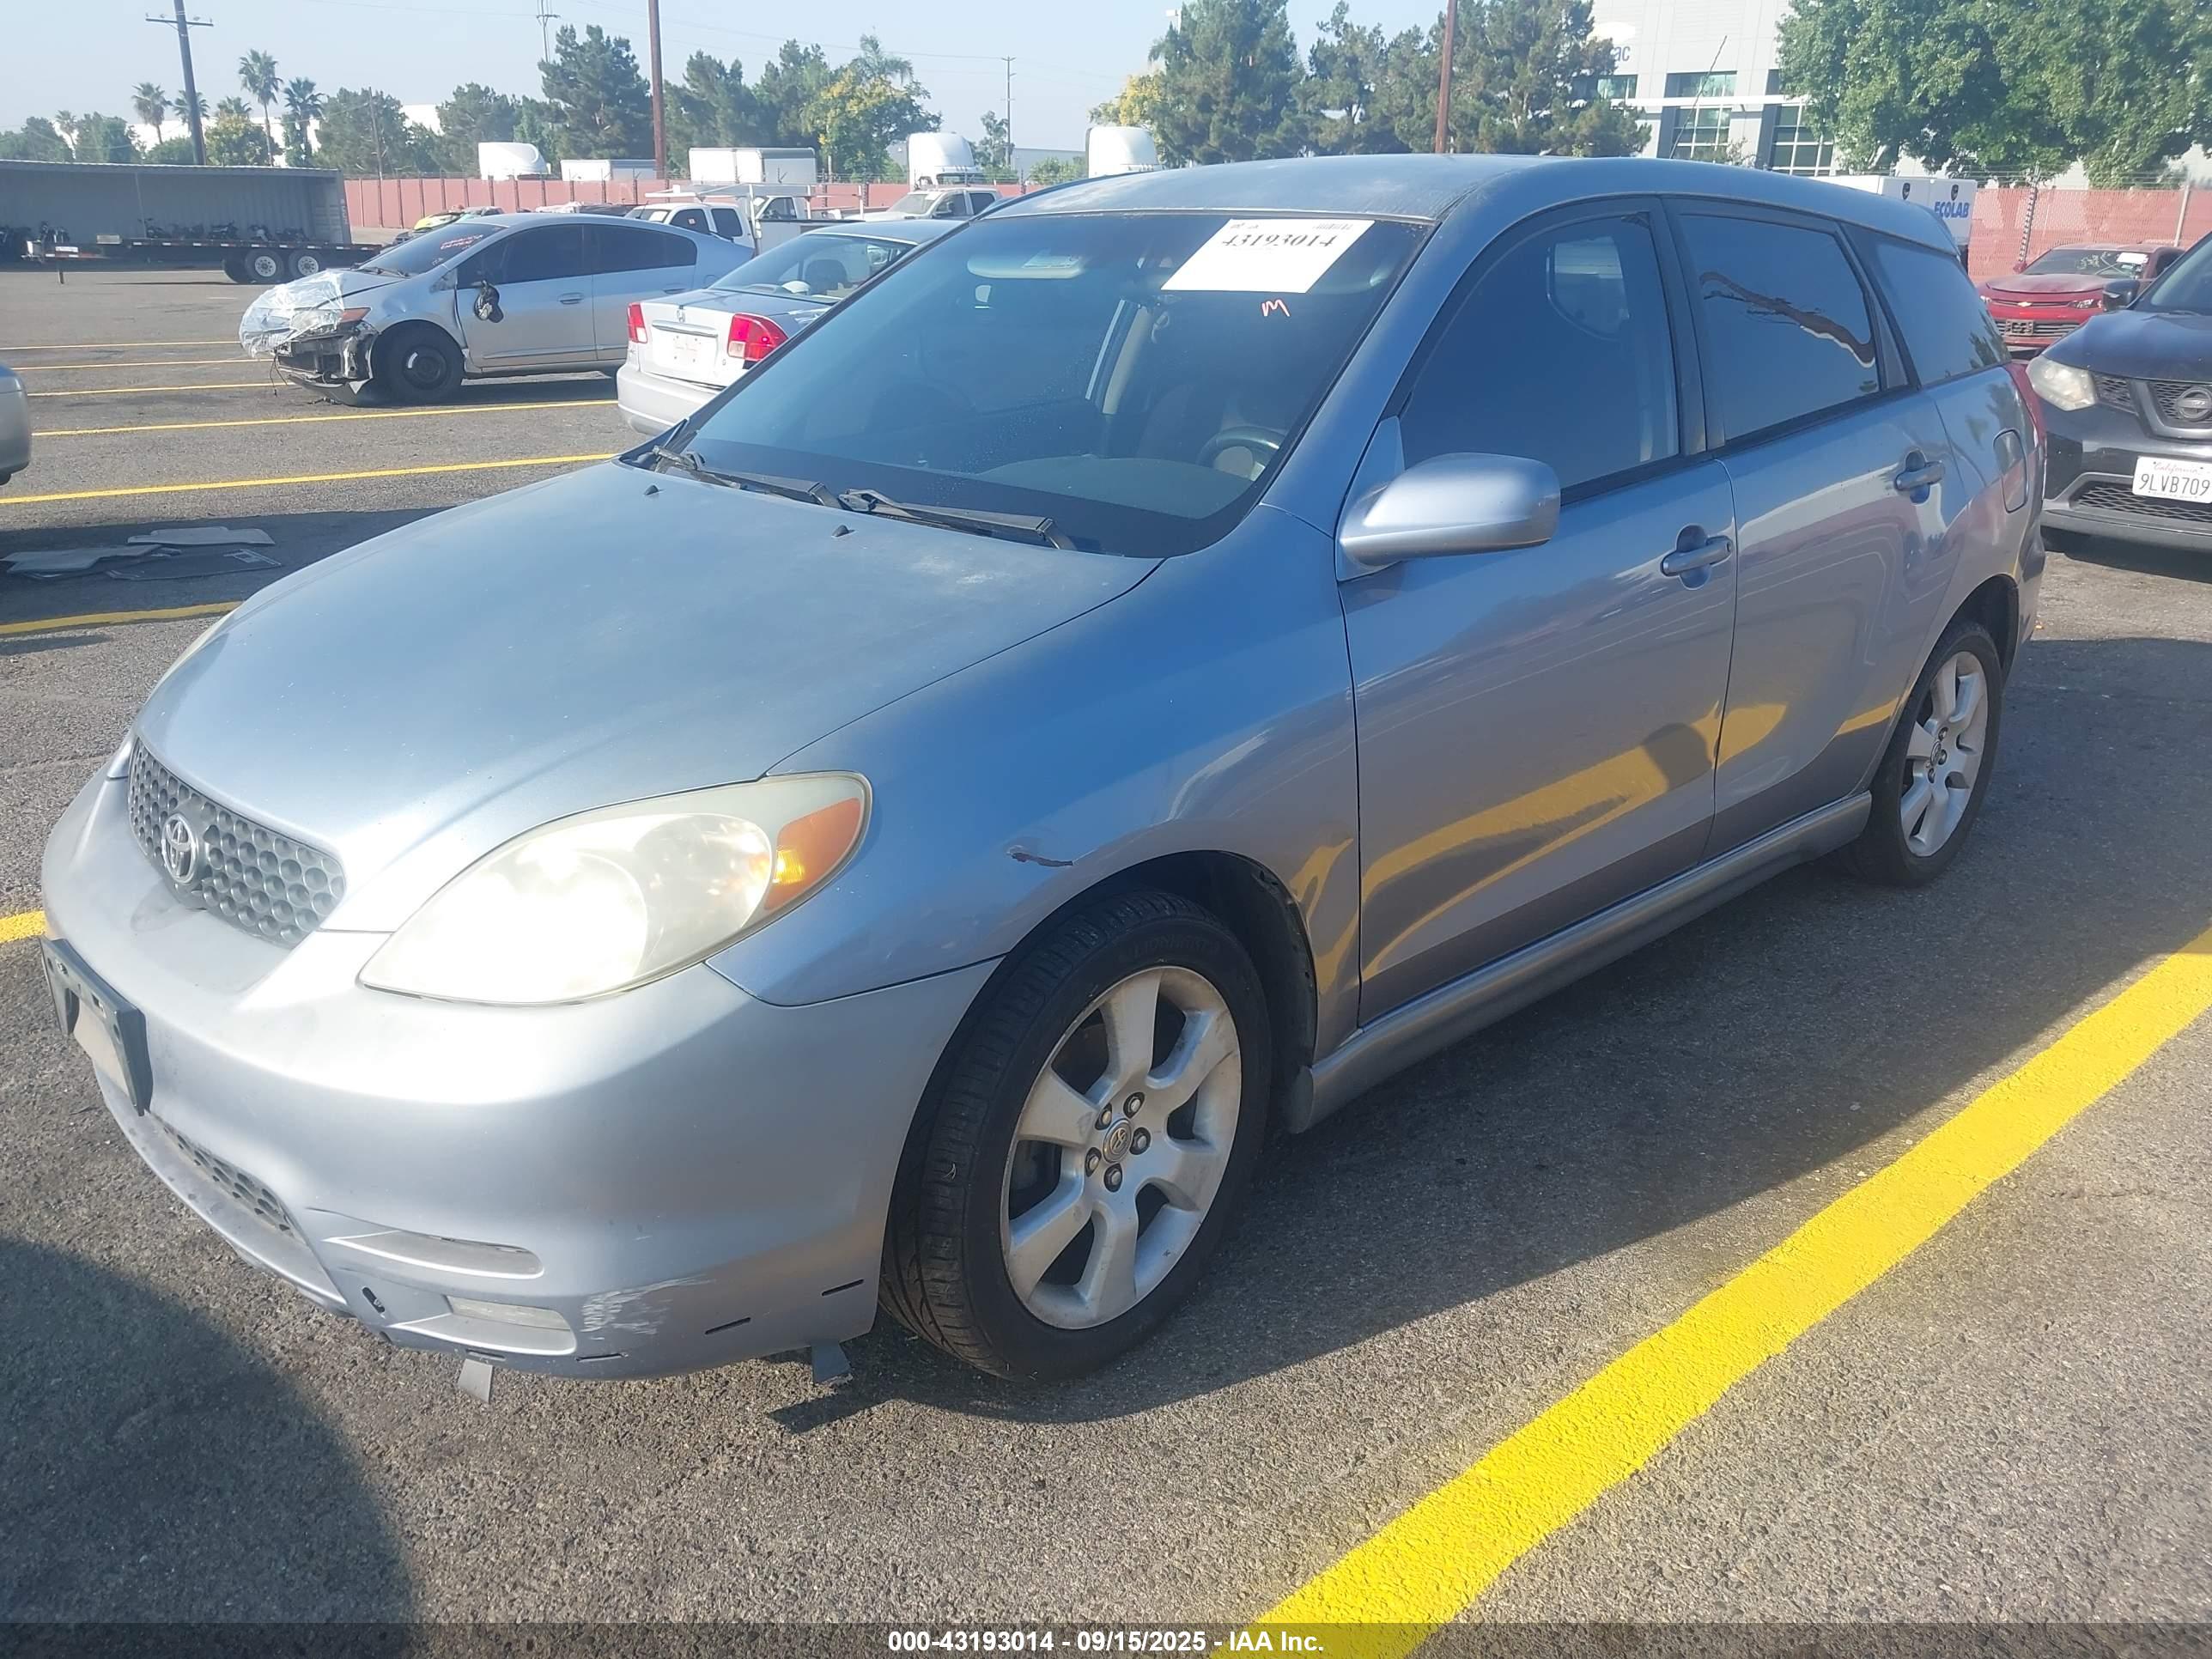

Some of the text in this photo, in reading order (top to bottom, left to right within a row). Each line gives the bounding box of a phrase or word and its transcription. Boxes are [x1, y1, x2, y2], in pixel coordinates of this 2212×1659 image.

[1934, 201, 1970, 218] ECOLAB
[1222, 233, 1337, 247] 43193014
[2138, 473, 2211, 496] 9LVB709
